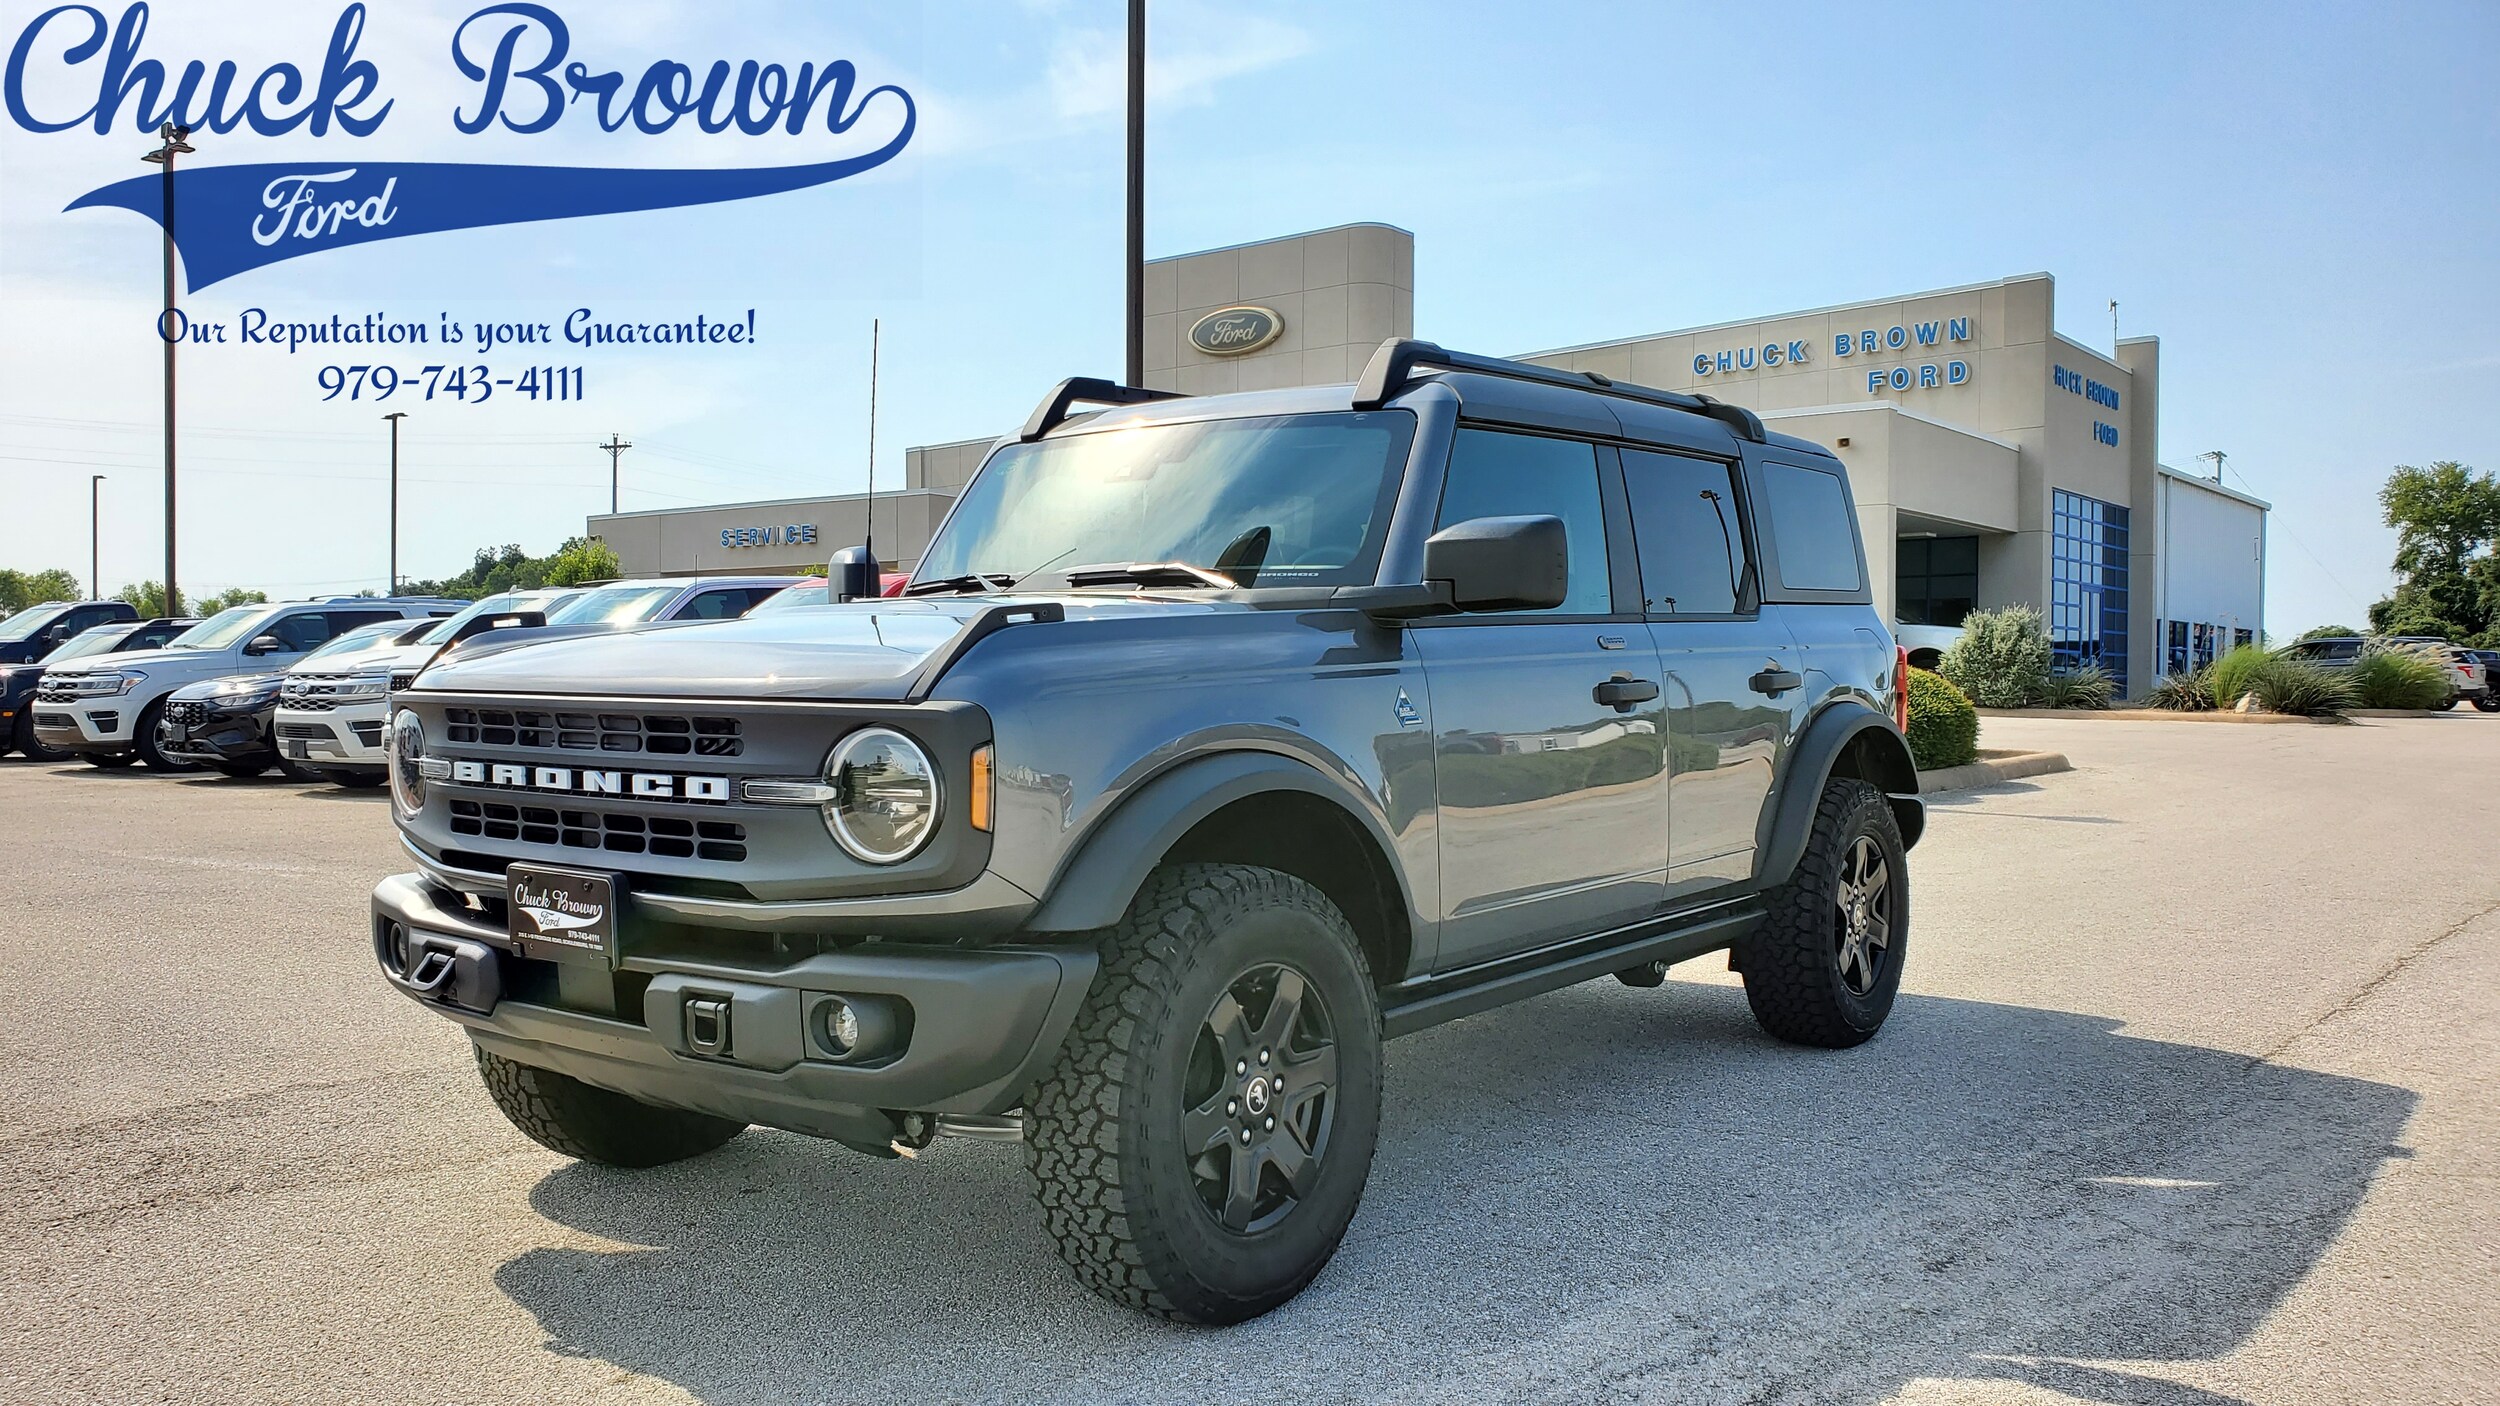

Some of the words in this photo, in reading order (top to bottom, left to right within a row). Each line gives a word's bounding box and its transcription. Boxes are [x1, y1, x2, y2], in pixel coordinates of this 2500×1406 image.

[1210, 317, 1258, 346] Ford
[1692, 339, 1810, 377] CHUCK
[1834, 316, 1974, 358] BROWN
[1866, 359, 1973, 395] FORD
[2093, 420, 2119, 448] FORD
[721, 524, 818, 548] SERVICE
[453, 760, 730, 801] BRONCO
[515, 883, 551, 908] Chuck
[552, 889, 602, 916] Brown
[539, 910, 560, 927] Ford
